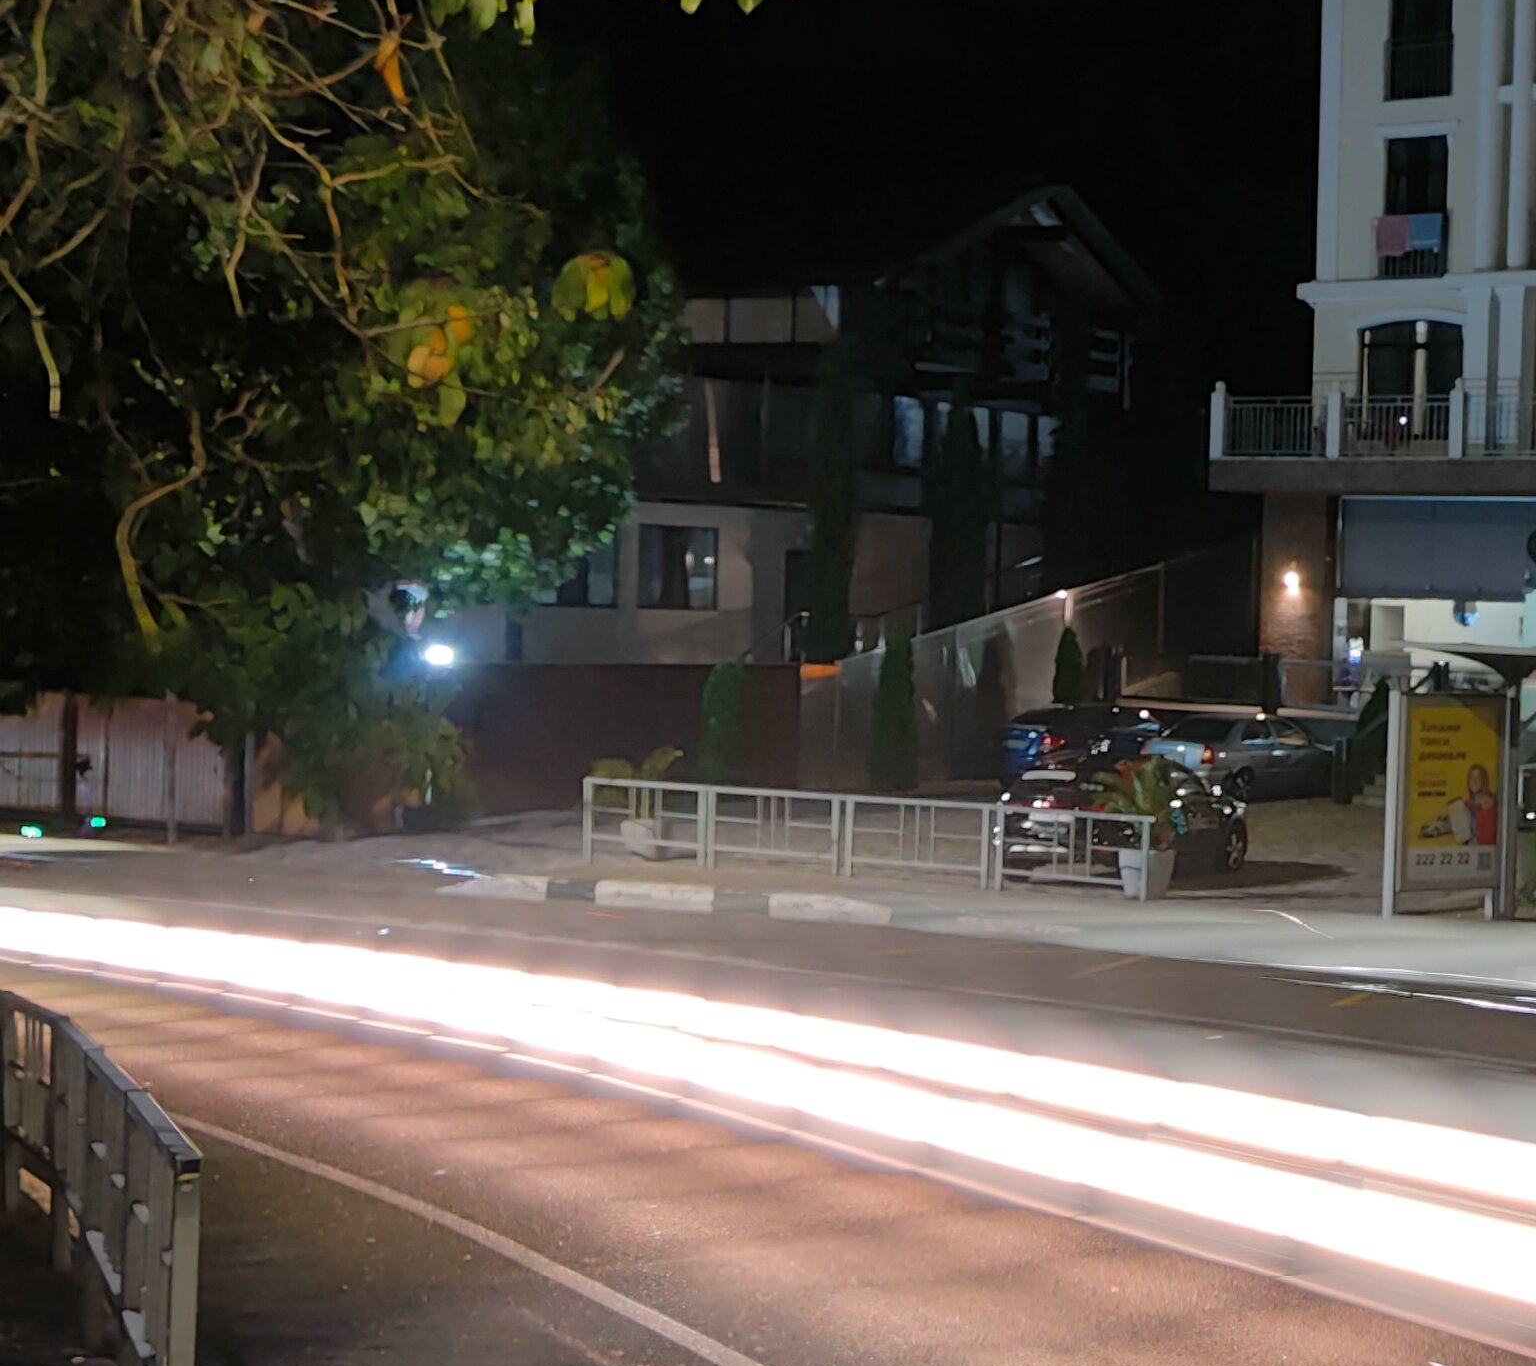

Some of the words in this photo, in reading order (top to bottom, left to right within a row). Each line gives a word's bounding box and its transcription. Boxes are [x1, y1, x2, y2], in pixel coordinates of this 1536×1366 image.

[1415, 853, 1436, 866] 222
[1440, 852, 1453, 865] 22
[1457, 851, 1470, 865] 22
